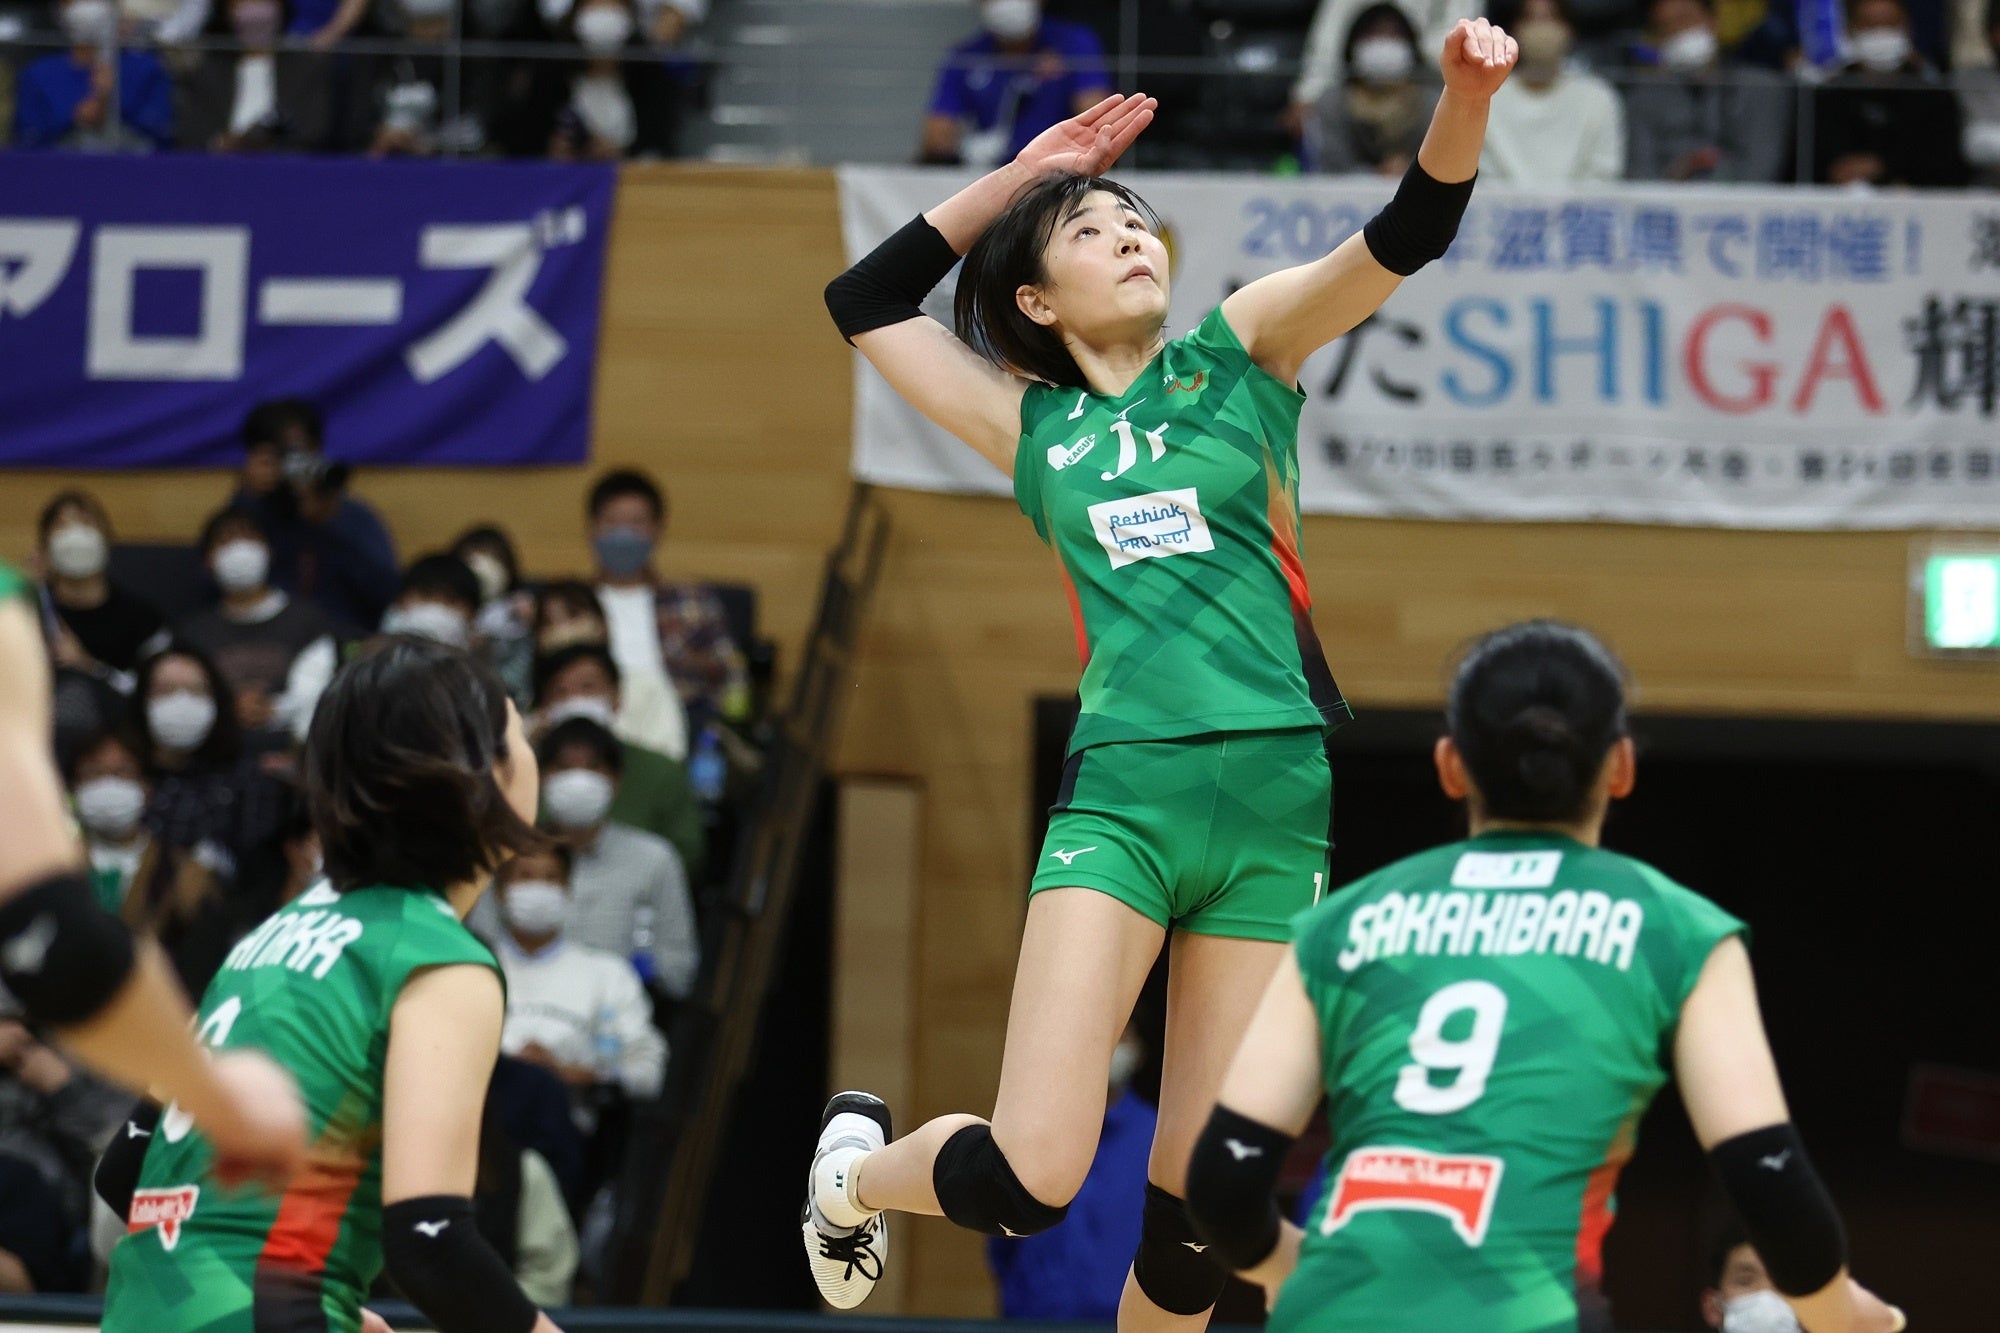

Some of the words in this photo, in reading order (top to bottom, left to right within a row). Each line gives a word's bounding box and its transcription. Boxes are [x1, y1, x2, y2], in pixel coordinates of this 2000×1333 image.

[1244, 201, 1922, 281] 202滋賀県で開催!
[1062, 434, 1096, 468] LEAGUE
[1109, 503, 1181, 528] Rethink
[1118, 530, 1191, 552] PROJECT
[1337, 889, 1643, 972] SAKAKIBARA
[1394, 979, 1508, 1116] 9
